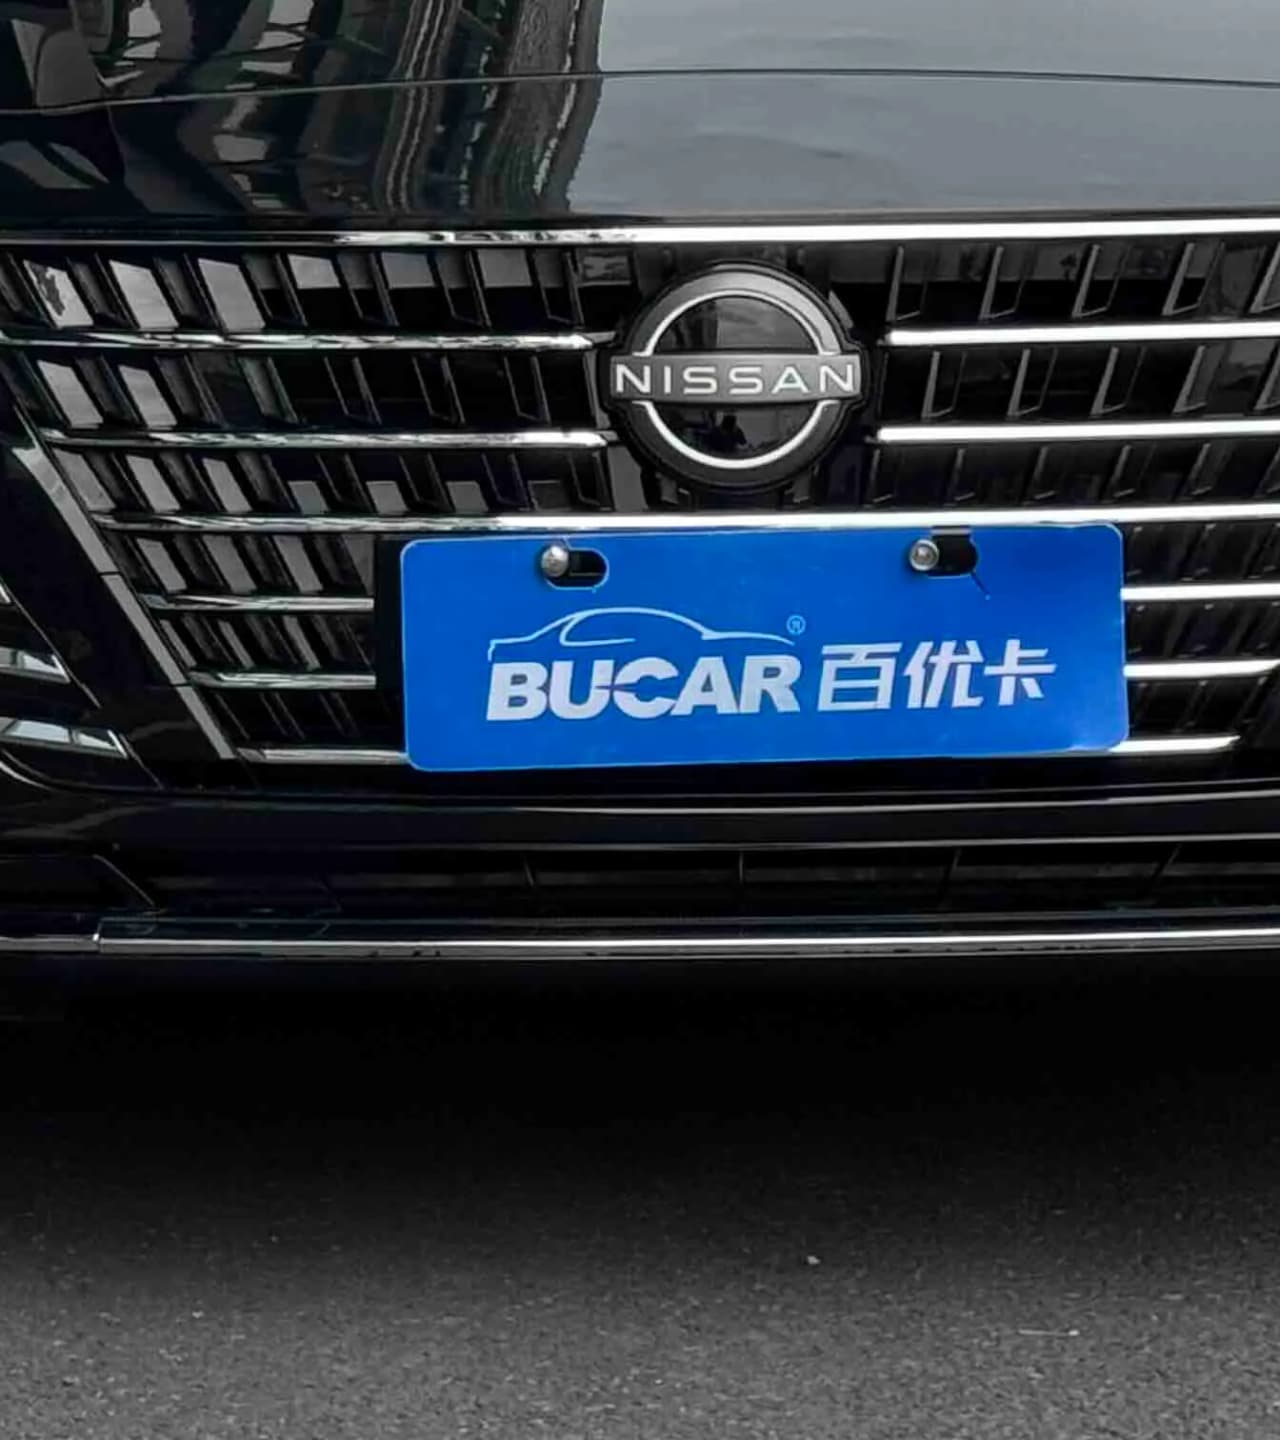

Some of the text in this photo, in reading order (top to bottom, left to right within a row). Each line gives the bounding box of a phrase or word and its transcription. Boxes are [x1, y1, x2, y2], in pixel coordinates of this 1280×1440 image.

[615, 363, 854, 395] NISSAN
[486, 638, 1057, 722] BUCAR 百优卡
